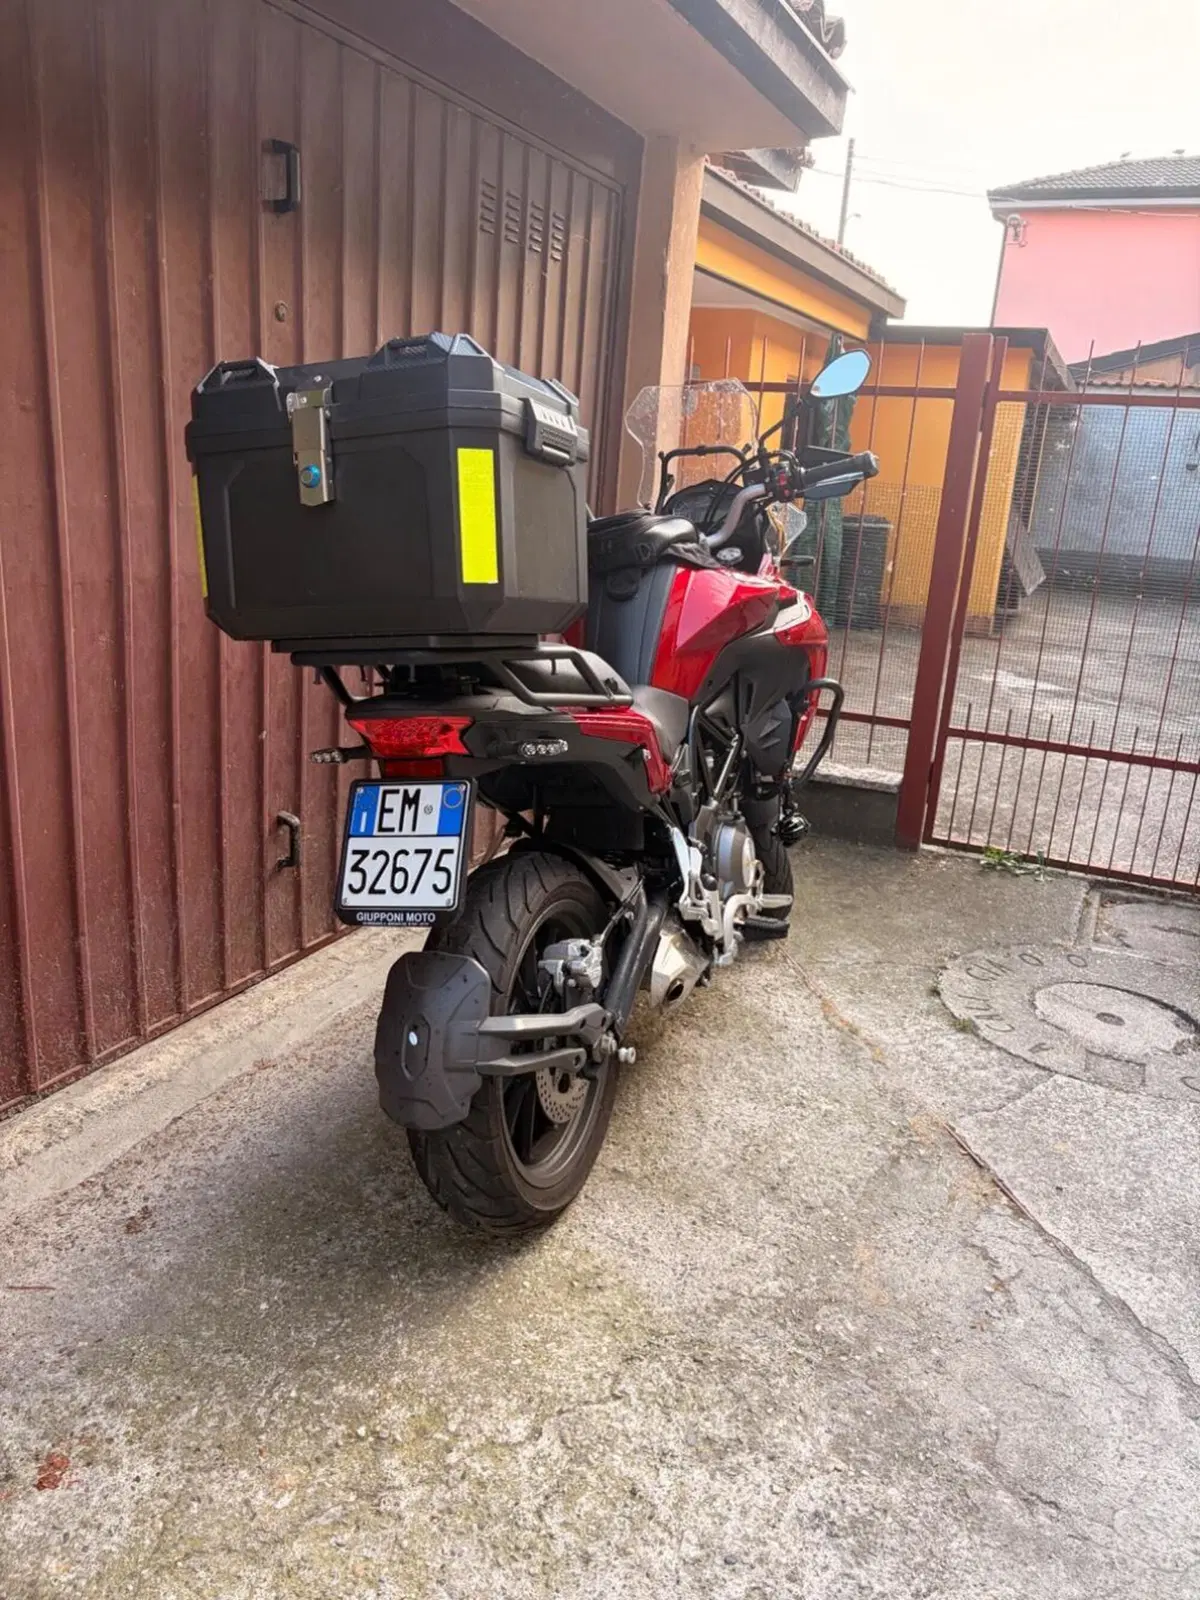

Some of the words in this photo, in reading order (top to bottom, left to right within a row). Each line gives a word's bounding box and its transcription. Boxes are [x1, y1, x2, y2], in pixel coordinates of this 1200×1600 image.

[378, 789, 421, 832] EM
[348, 849, 454, 895] 32675
[356, 912, 404, 922] GIUPPONI
[406, 912, 436, 922] MOTO
